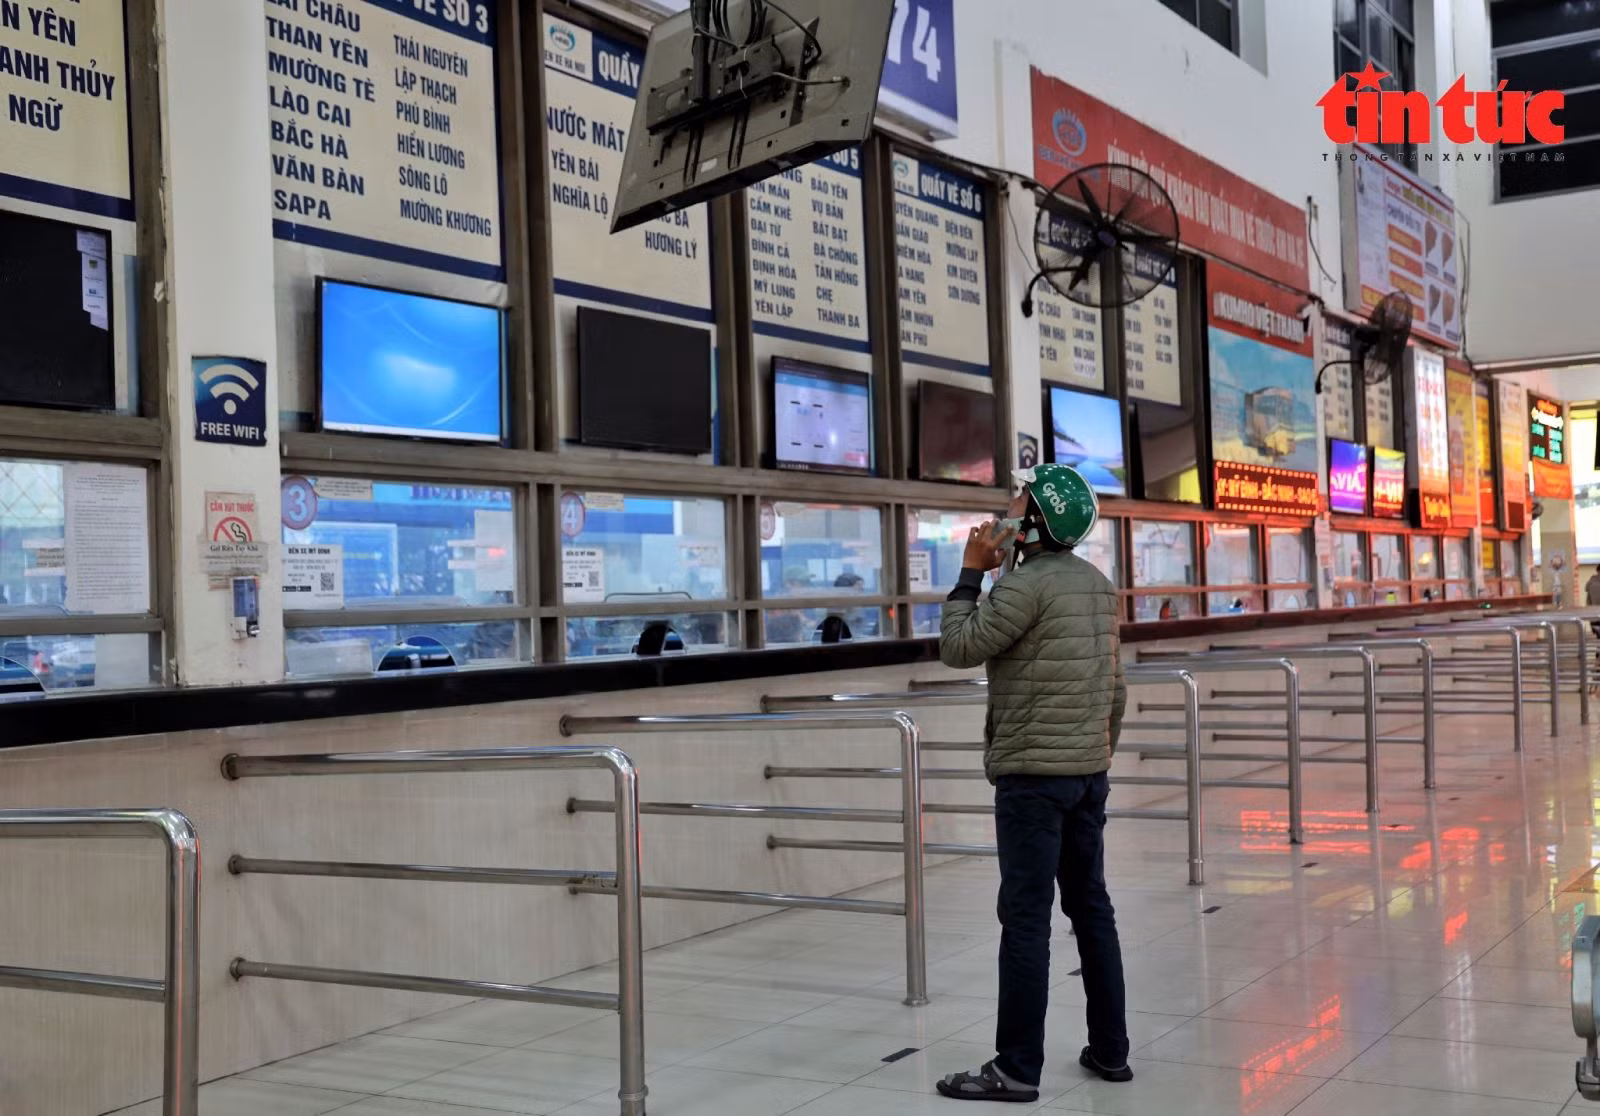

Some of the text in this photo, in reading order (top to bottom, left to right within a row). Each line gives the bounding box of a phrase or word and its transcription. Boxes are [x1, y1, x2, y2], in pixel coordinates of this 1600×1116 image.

[28, 7, 76, 46] YÊN
[306, 0, 361, 32] CHÂU
[475, 4, 488, 34] 3
[265, 15, 368, 68] THAN YÊN
[394, 34, 468, 78] THÁI NGUYÊN
[57, 59, 115, 101] THỦY
[268, 50, 376, 103] MƯỜNG TÈ
[396, 66, 457, 105] LẬP THẠCH
[9, 94, 63, 131] NGỮ
[269, 85, 351, 128] LÀO CAI
[396, 99, 451, 134] PHÚ BÌNH
[271, 118, 349, 160] BẮC HÀ
[592, 121, 625, 153] MÁT
[428, 142, 465, 169] LƯƠNG
[552, 148, 599, 181] YÊN BÁI
[850, 148, 859, 171] 5
[272, 153, 365, 196] VĂN BÀN
[399, 163, 448, 196] SÔNG LÔ
[274, 189, 332, 221] SAPA
[553, 182, 609, 220] NGHĨA LỘ
[831, 184, 848, 201] YÊN
[947, 181, 959, 206] VÉ
[975, 193, 982, 213] 6
[400, 198, 491, 237] MƯỜNG KHƯƠNG
[645, 230, 697, 260] HƯƠNG LÝ
[755, 299, 773, 315] YÊN
[771, 283, 795, 300] LUNG
[818, 307, 860, 329] THANH BA
[201, 422, 259, 440] FREE WIFI
[288, 485, 308, 522] 3
[1042, 482, 1067, 515] Grab
